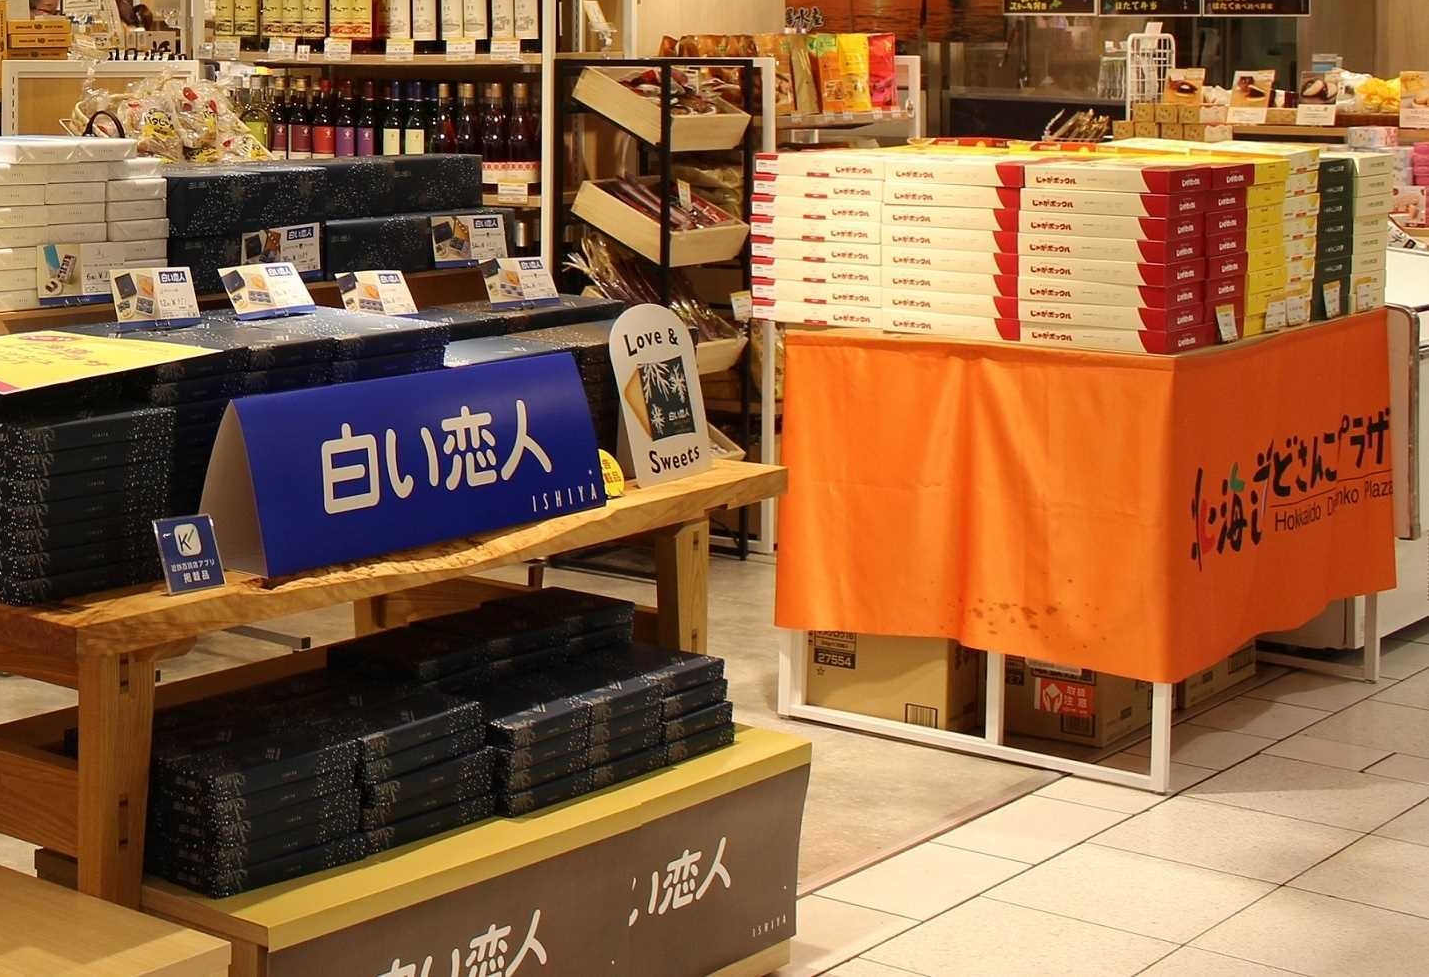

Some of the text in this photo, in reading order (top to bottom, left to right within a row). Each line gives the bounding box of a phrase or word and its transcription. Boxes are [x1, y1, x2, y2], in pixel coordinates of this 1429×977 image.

[624, 327, 679, 357] Love &
[321, 399, 553, 515] 白い恋人
[649, 446, 700, 473] Sweets
[532, 480, 599, 513] ISHIYA
[817, 652, 852, 667] 27554
